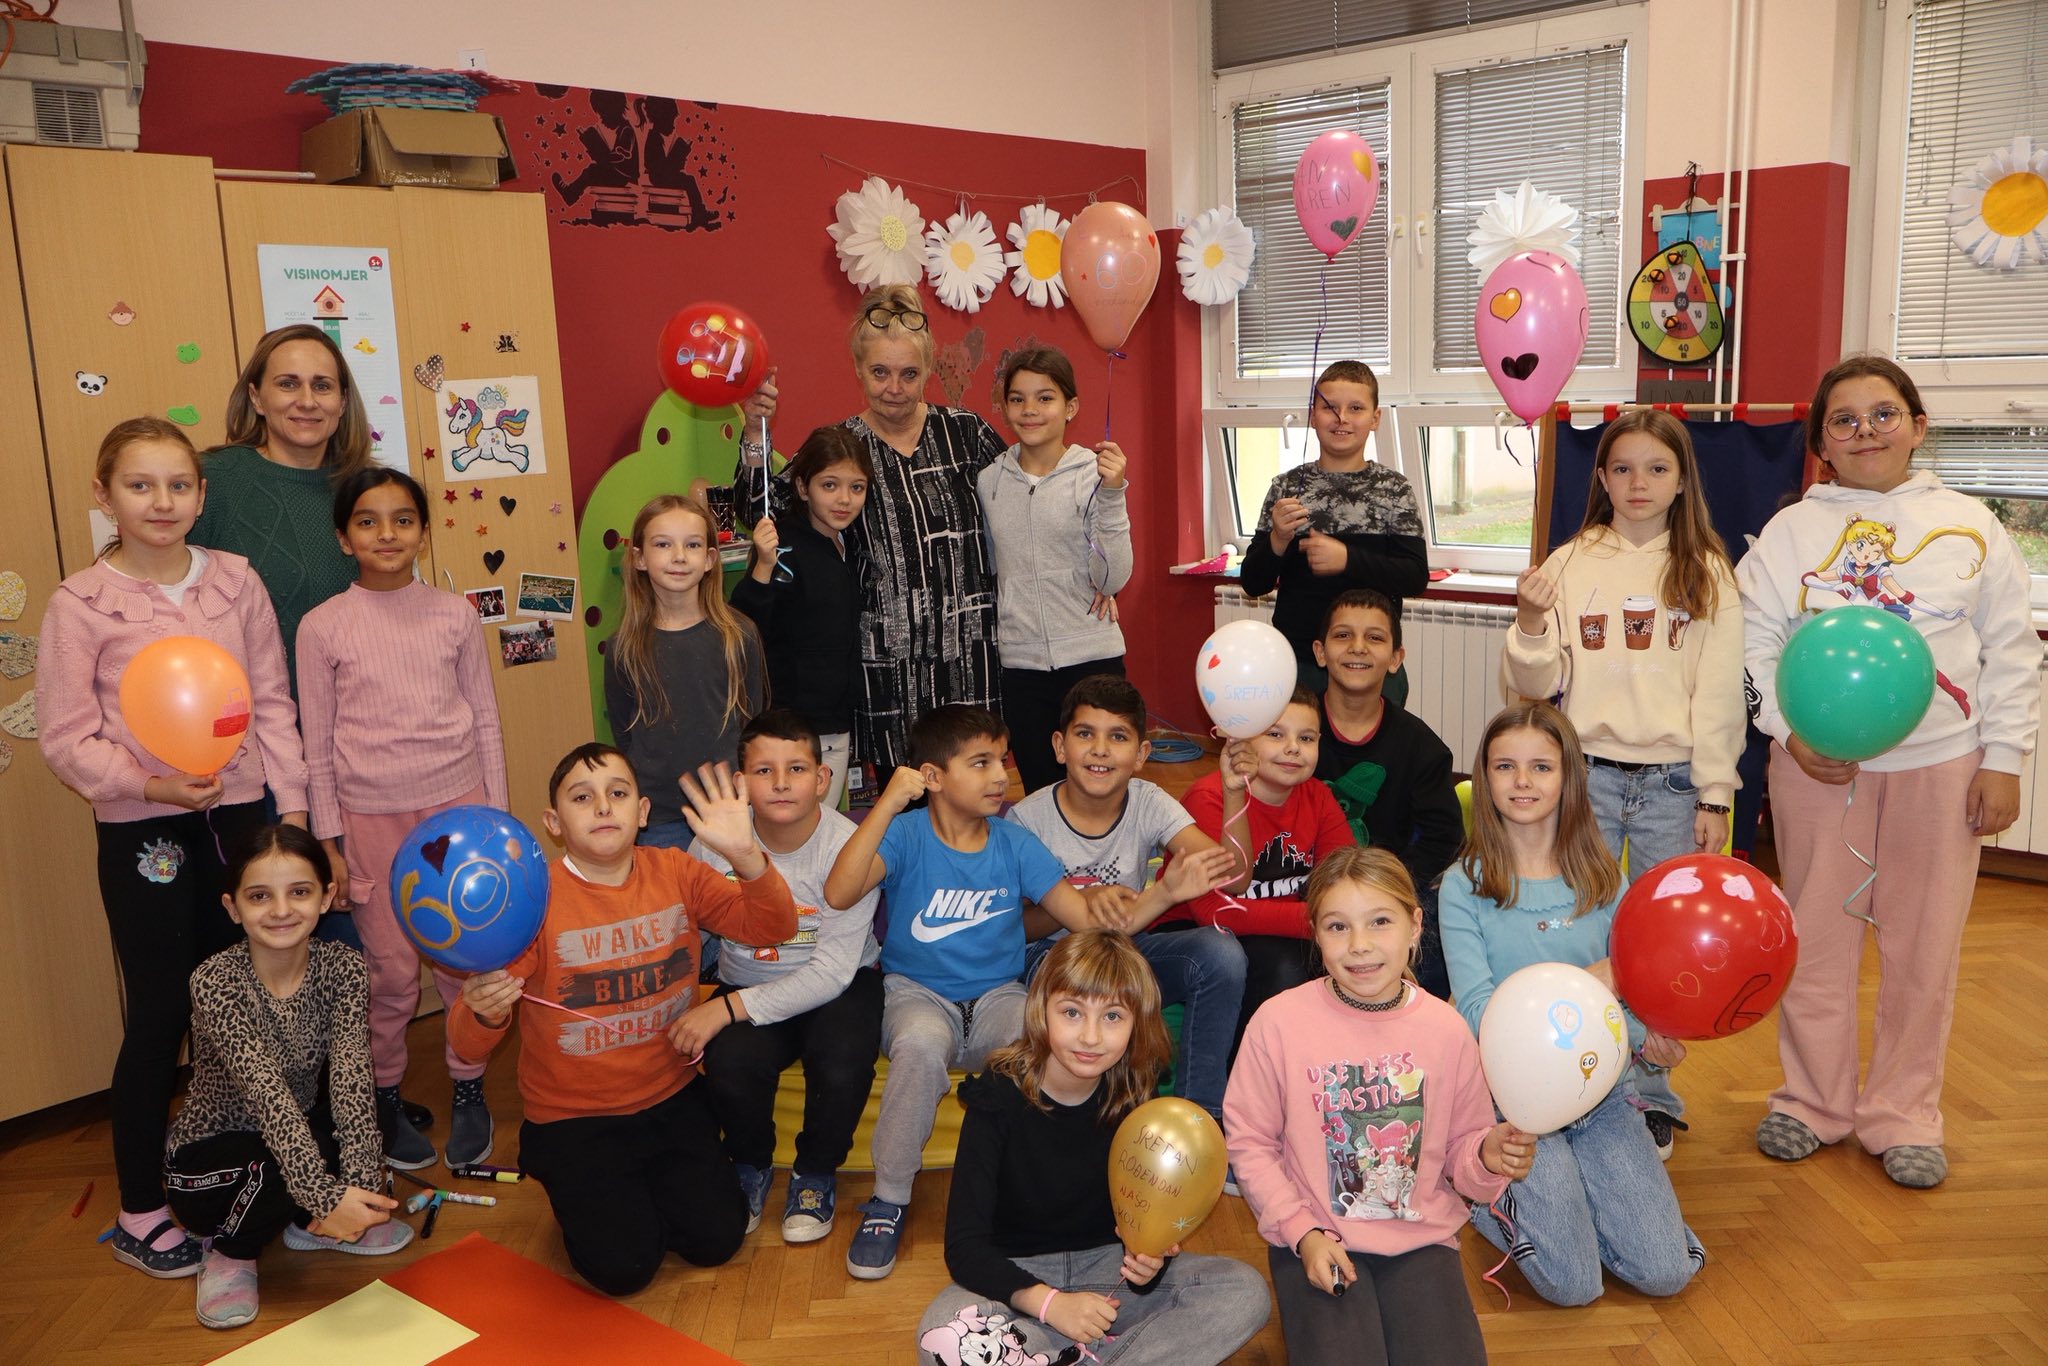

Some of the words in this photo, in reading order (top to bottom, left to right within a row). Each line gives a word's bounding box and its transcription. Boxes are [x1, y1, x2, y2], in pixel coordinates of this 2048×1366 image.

[283, 268, 369, 281] VISINOMJER
[1095, 250, 1148, 290] 60
[1677, 271, 1688, 281] 20
[1661, 284, 1671, 296] 10
[1677, 298, 1688, 308] 50
[1661, 309, 1668, 318] 5
[1694, 309, 1703, 320] 10
[1640, 320, 1651, 331] 10
[1709, 320, 1719, 331] 20
[1678, 343, 1690, 353] 40
[1224, 681, 1284, 701] SRETAN
[401, 856, 510, 950] 60
[925, 888, 998, 921] NIKE
[584, 1004, 674, 1052] REPEAT
[1582, 1057, 1595, 1066] 60
[1306, 1060, 1350, 1087] USE
[1363, 1051, 1417, 1084] LESS
[1311, 1083, 1402, 1112] PLASTIC
[1133, 1124, 1199, 1176] SRETAN
